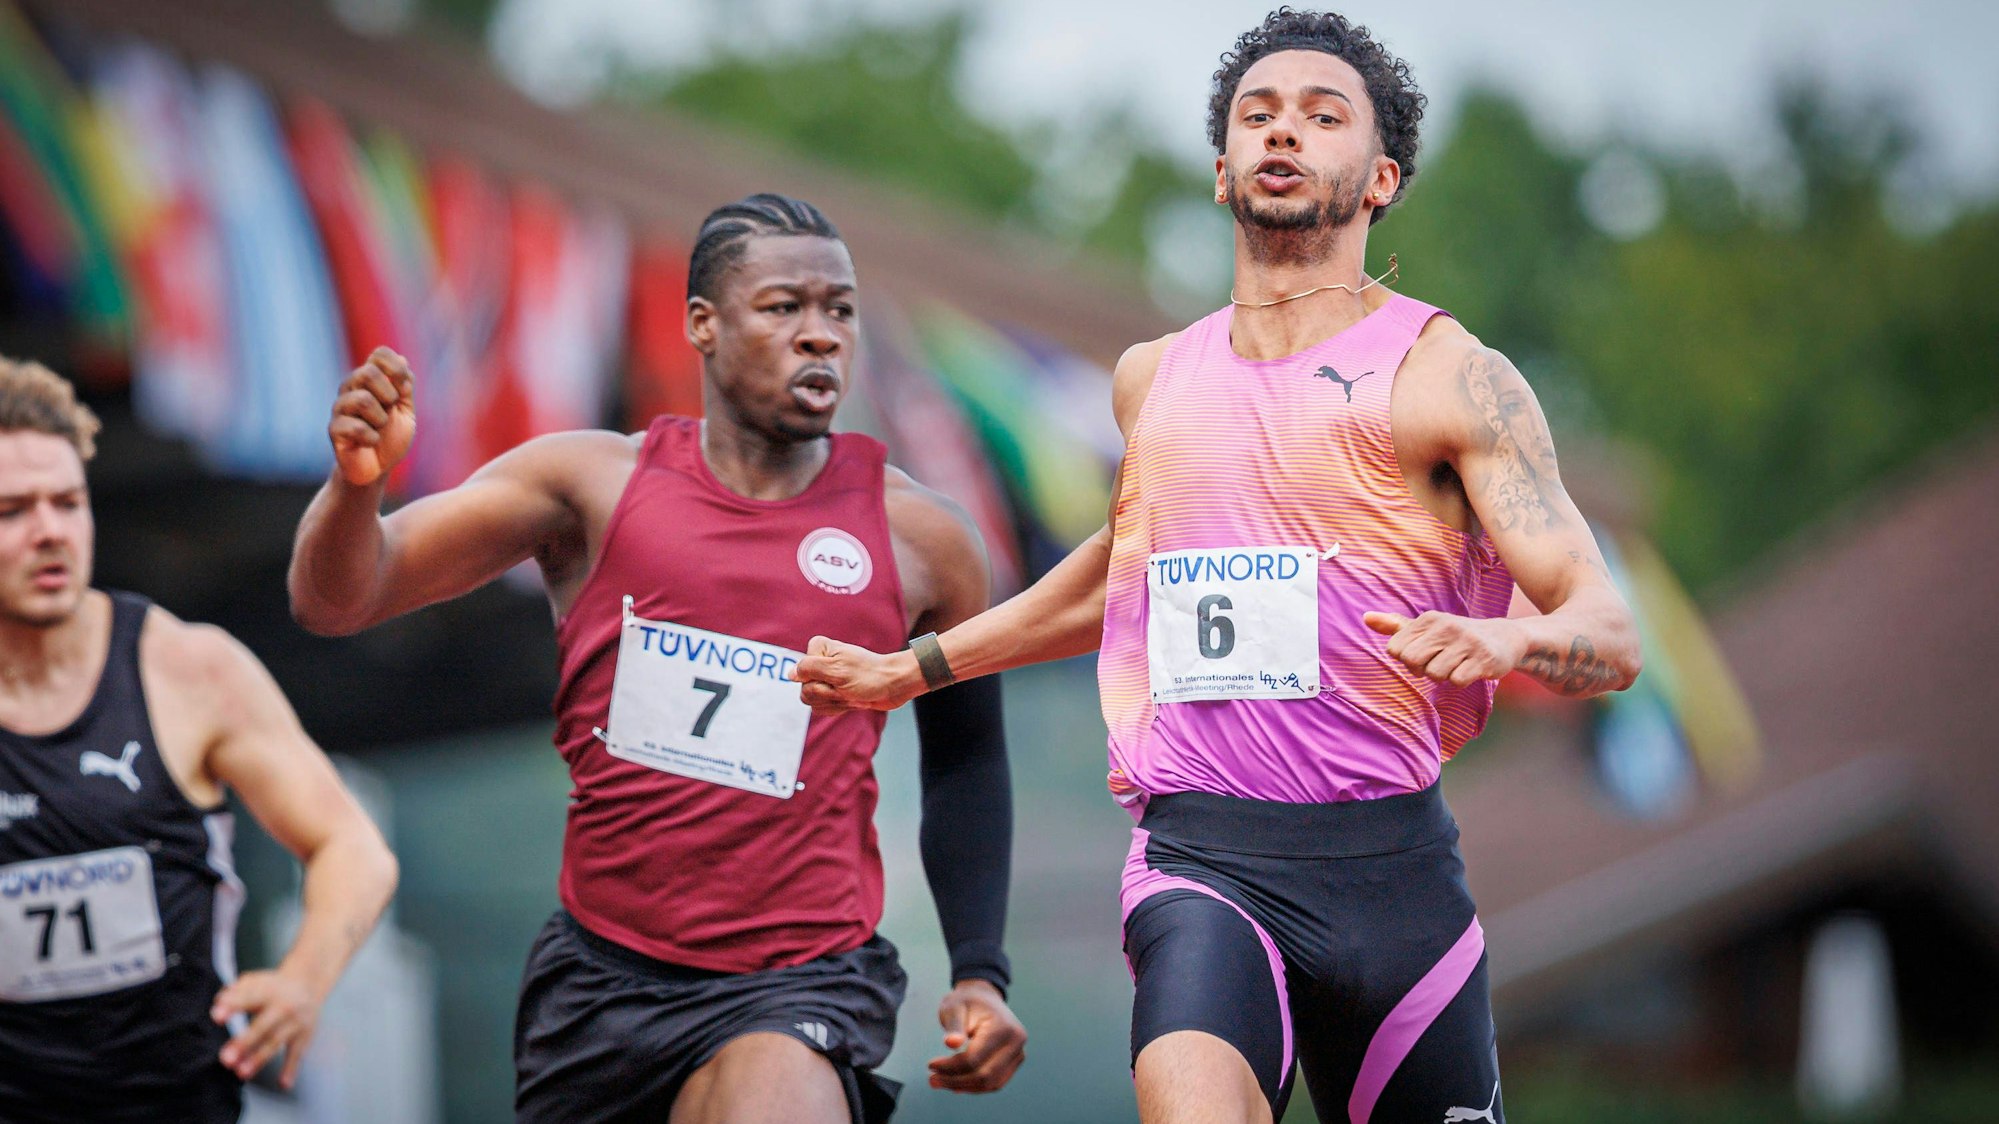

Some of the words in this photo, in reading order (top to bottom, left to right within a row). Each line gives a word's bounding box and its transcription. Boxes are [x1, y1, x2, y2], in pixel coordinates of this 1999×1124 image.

[813, 553, 859, 570] ASV
[1157, 553, 1300, 586] TÜVNORD
[639, 625, 798, 682] TÜVNORD
[1196, 593, 1236, 660] 6
[1185, 673, 1254, 683] Internationales
[690, 676, 732, 739] 7
[23, 898, 96, 965] 71
